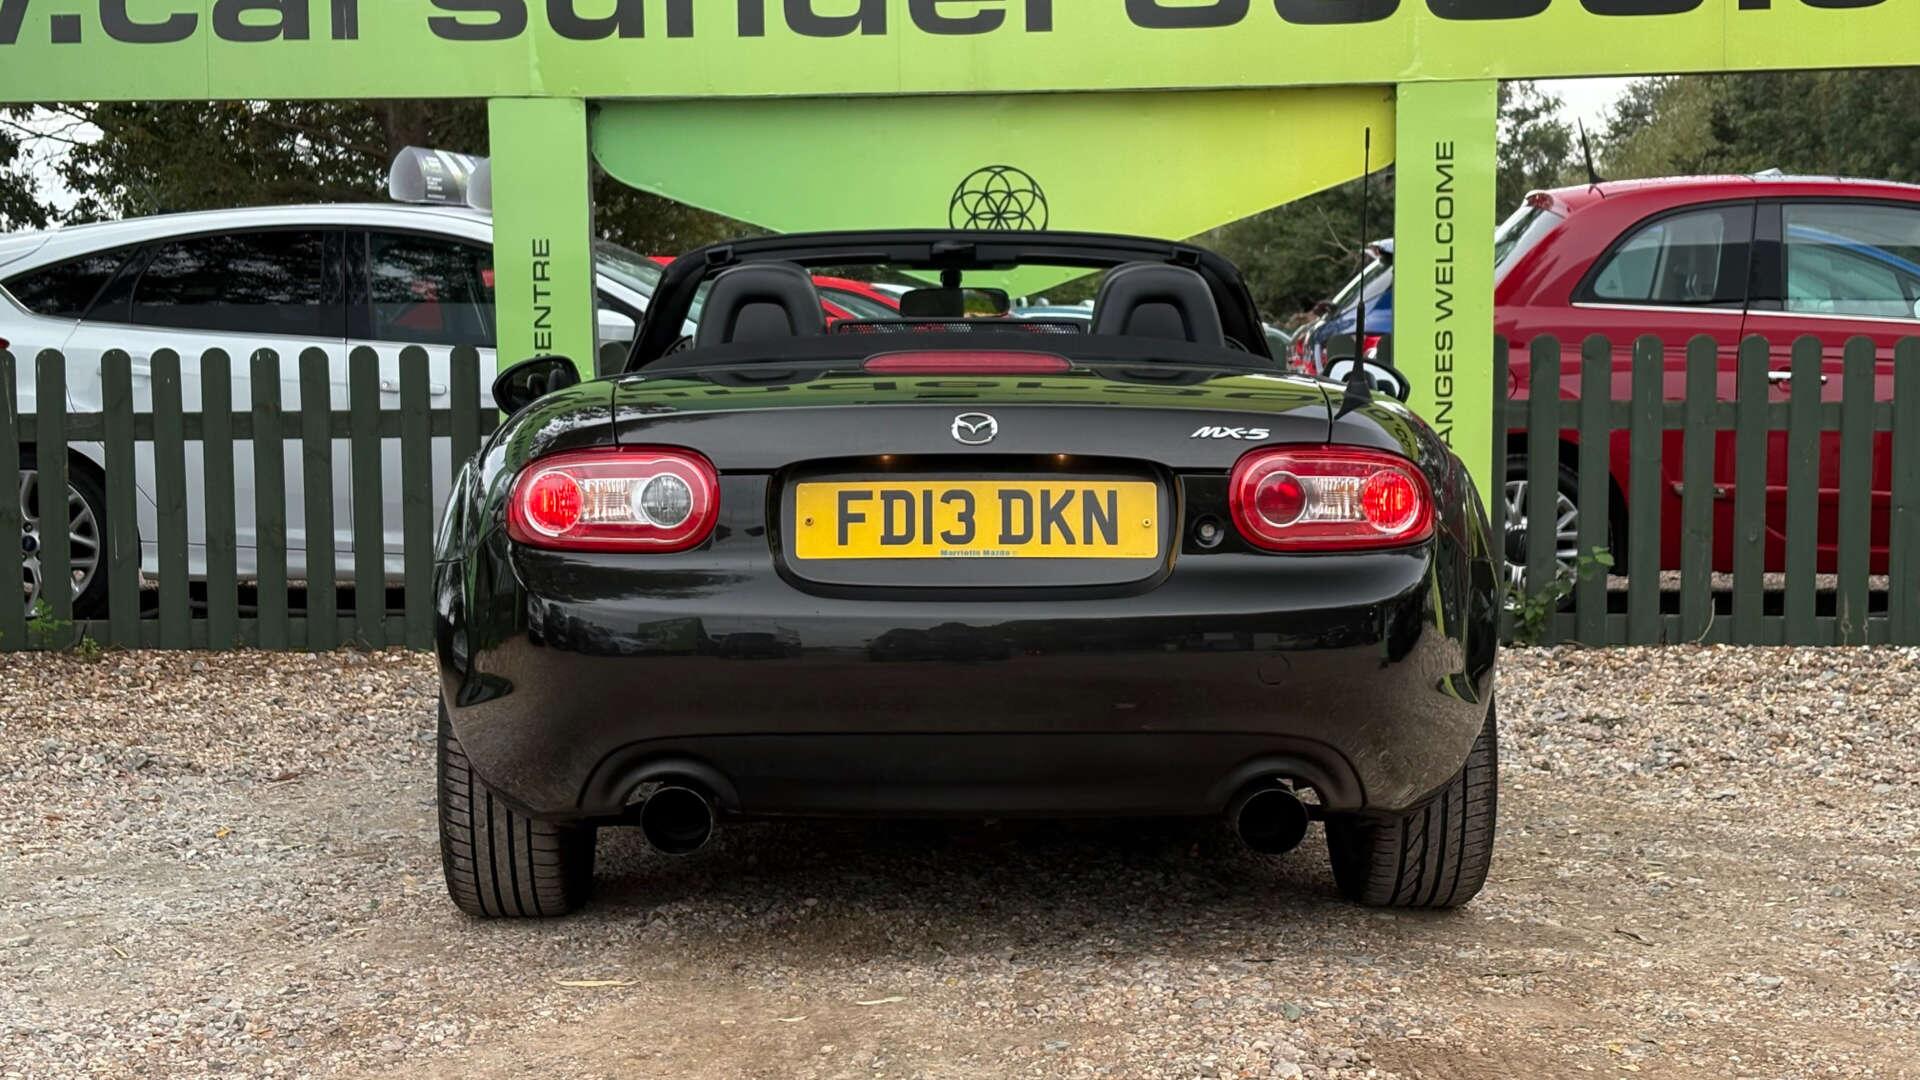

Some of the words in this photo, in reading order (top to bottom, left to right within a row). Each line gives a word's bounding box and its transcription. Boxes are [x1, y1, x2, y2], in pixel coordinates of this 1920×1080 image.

[1435, 141, 1454, 322] WELCOME
[532, 238, 552, 357] ENTRE
[1190, 426, 1270, 440] MX-5
[837, 488, 976, 546] FD13
[997, 488, 1118, 546] DKN
[983, 549, 1010, 557] Mazda
